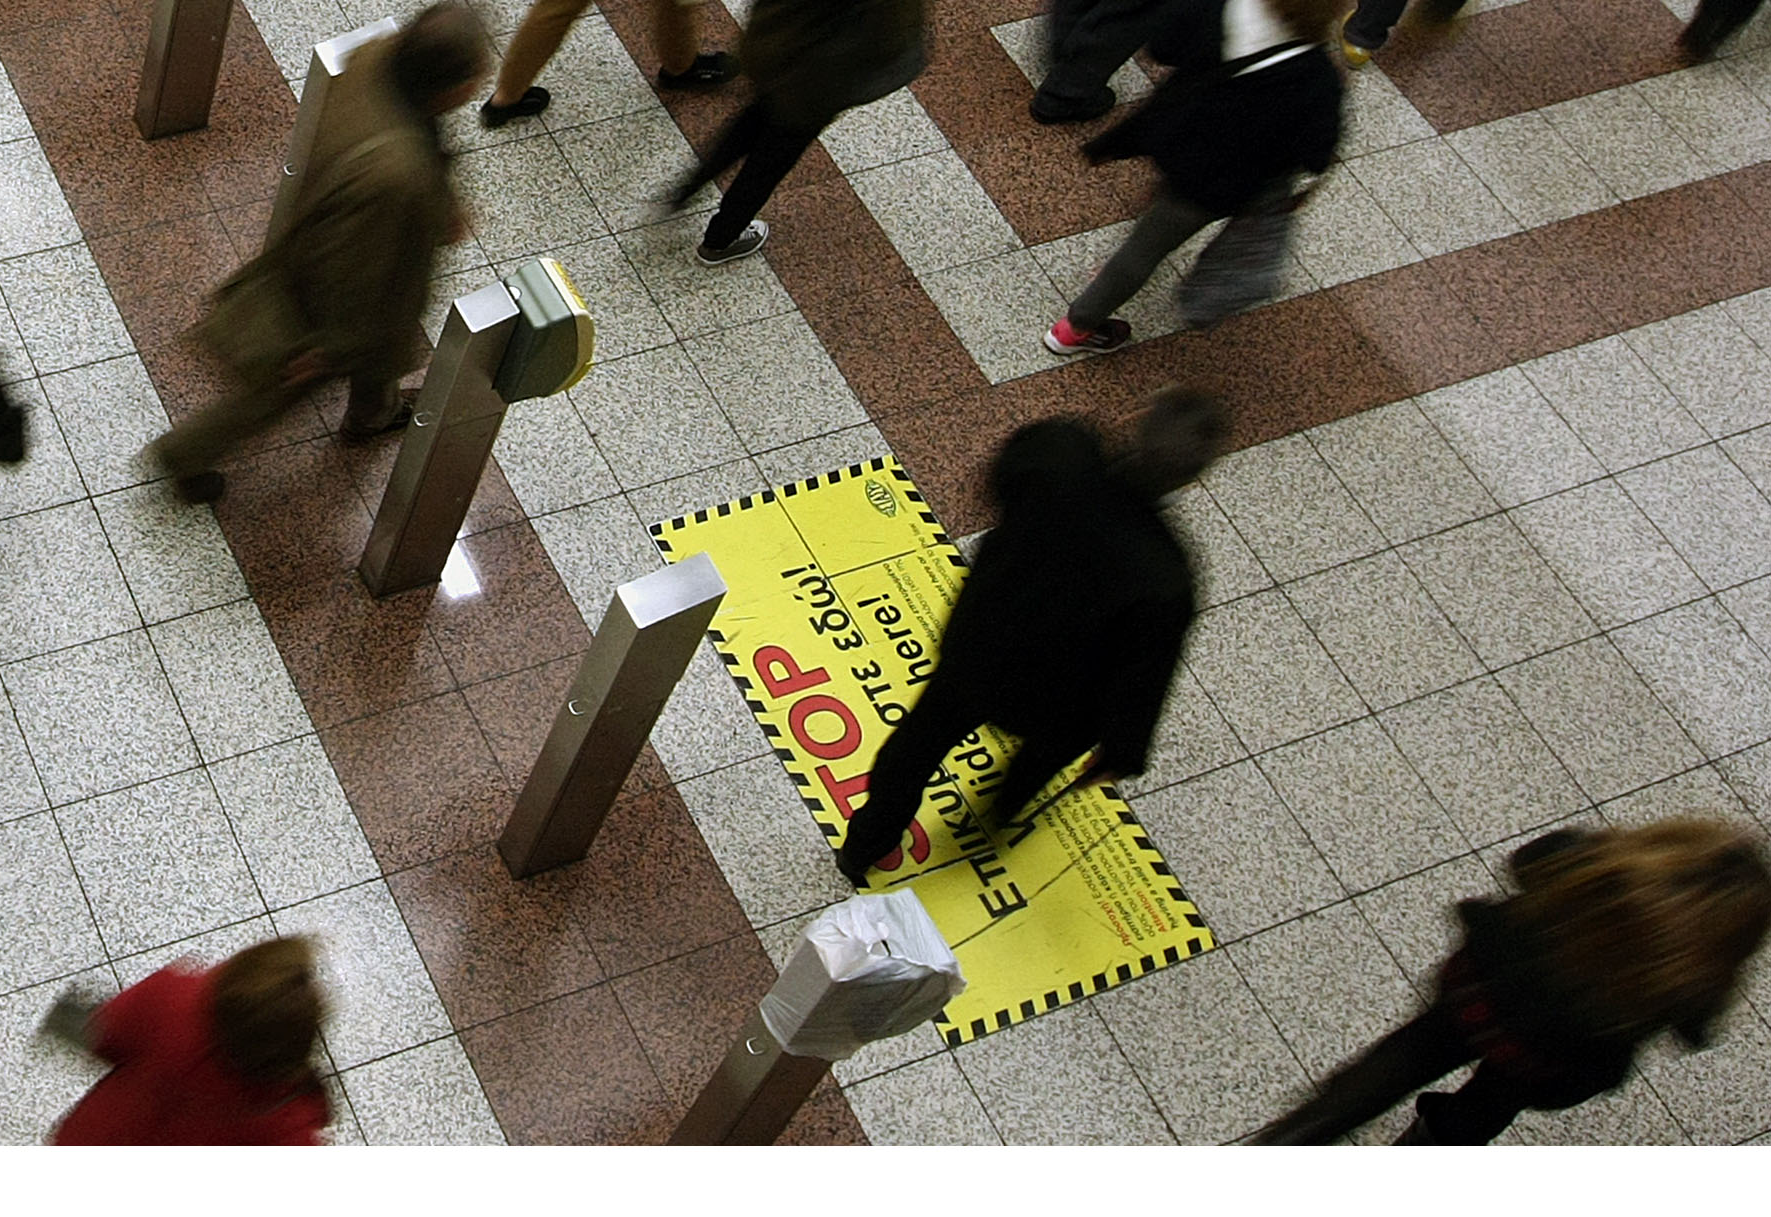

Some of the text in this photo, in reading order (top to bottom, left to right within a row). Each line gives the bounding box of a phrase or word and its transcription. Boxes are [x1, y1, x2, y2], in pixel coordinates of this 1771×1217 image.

[856, 592, 939, 686] here!
[778, 561, 1028, 919] Επικυρστε εδώ!
[1078, 805, 1092, 818] the
[1112, 854, 1125, 868] are
[1114, 838, 1136, 865] travel
[1121, 870, 1137, 886] You
[1132, 865, 1151, 888] valid
[1133, 888, 1167, 933] Attention!
[1152, 896, 1180, 929] having
